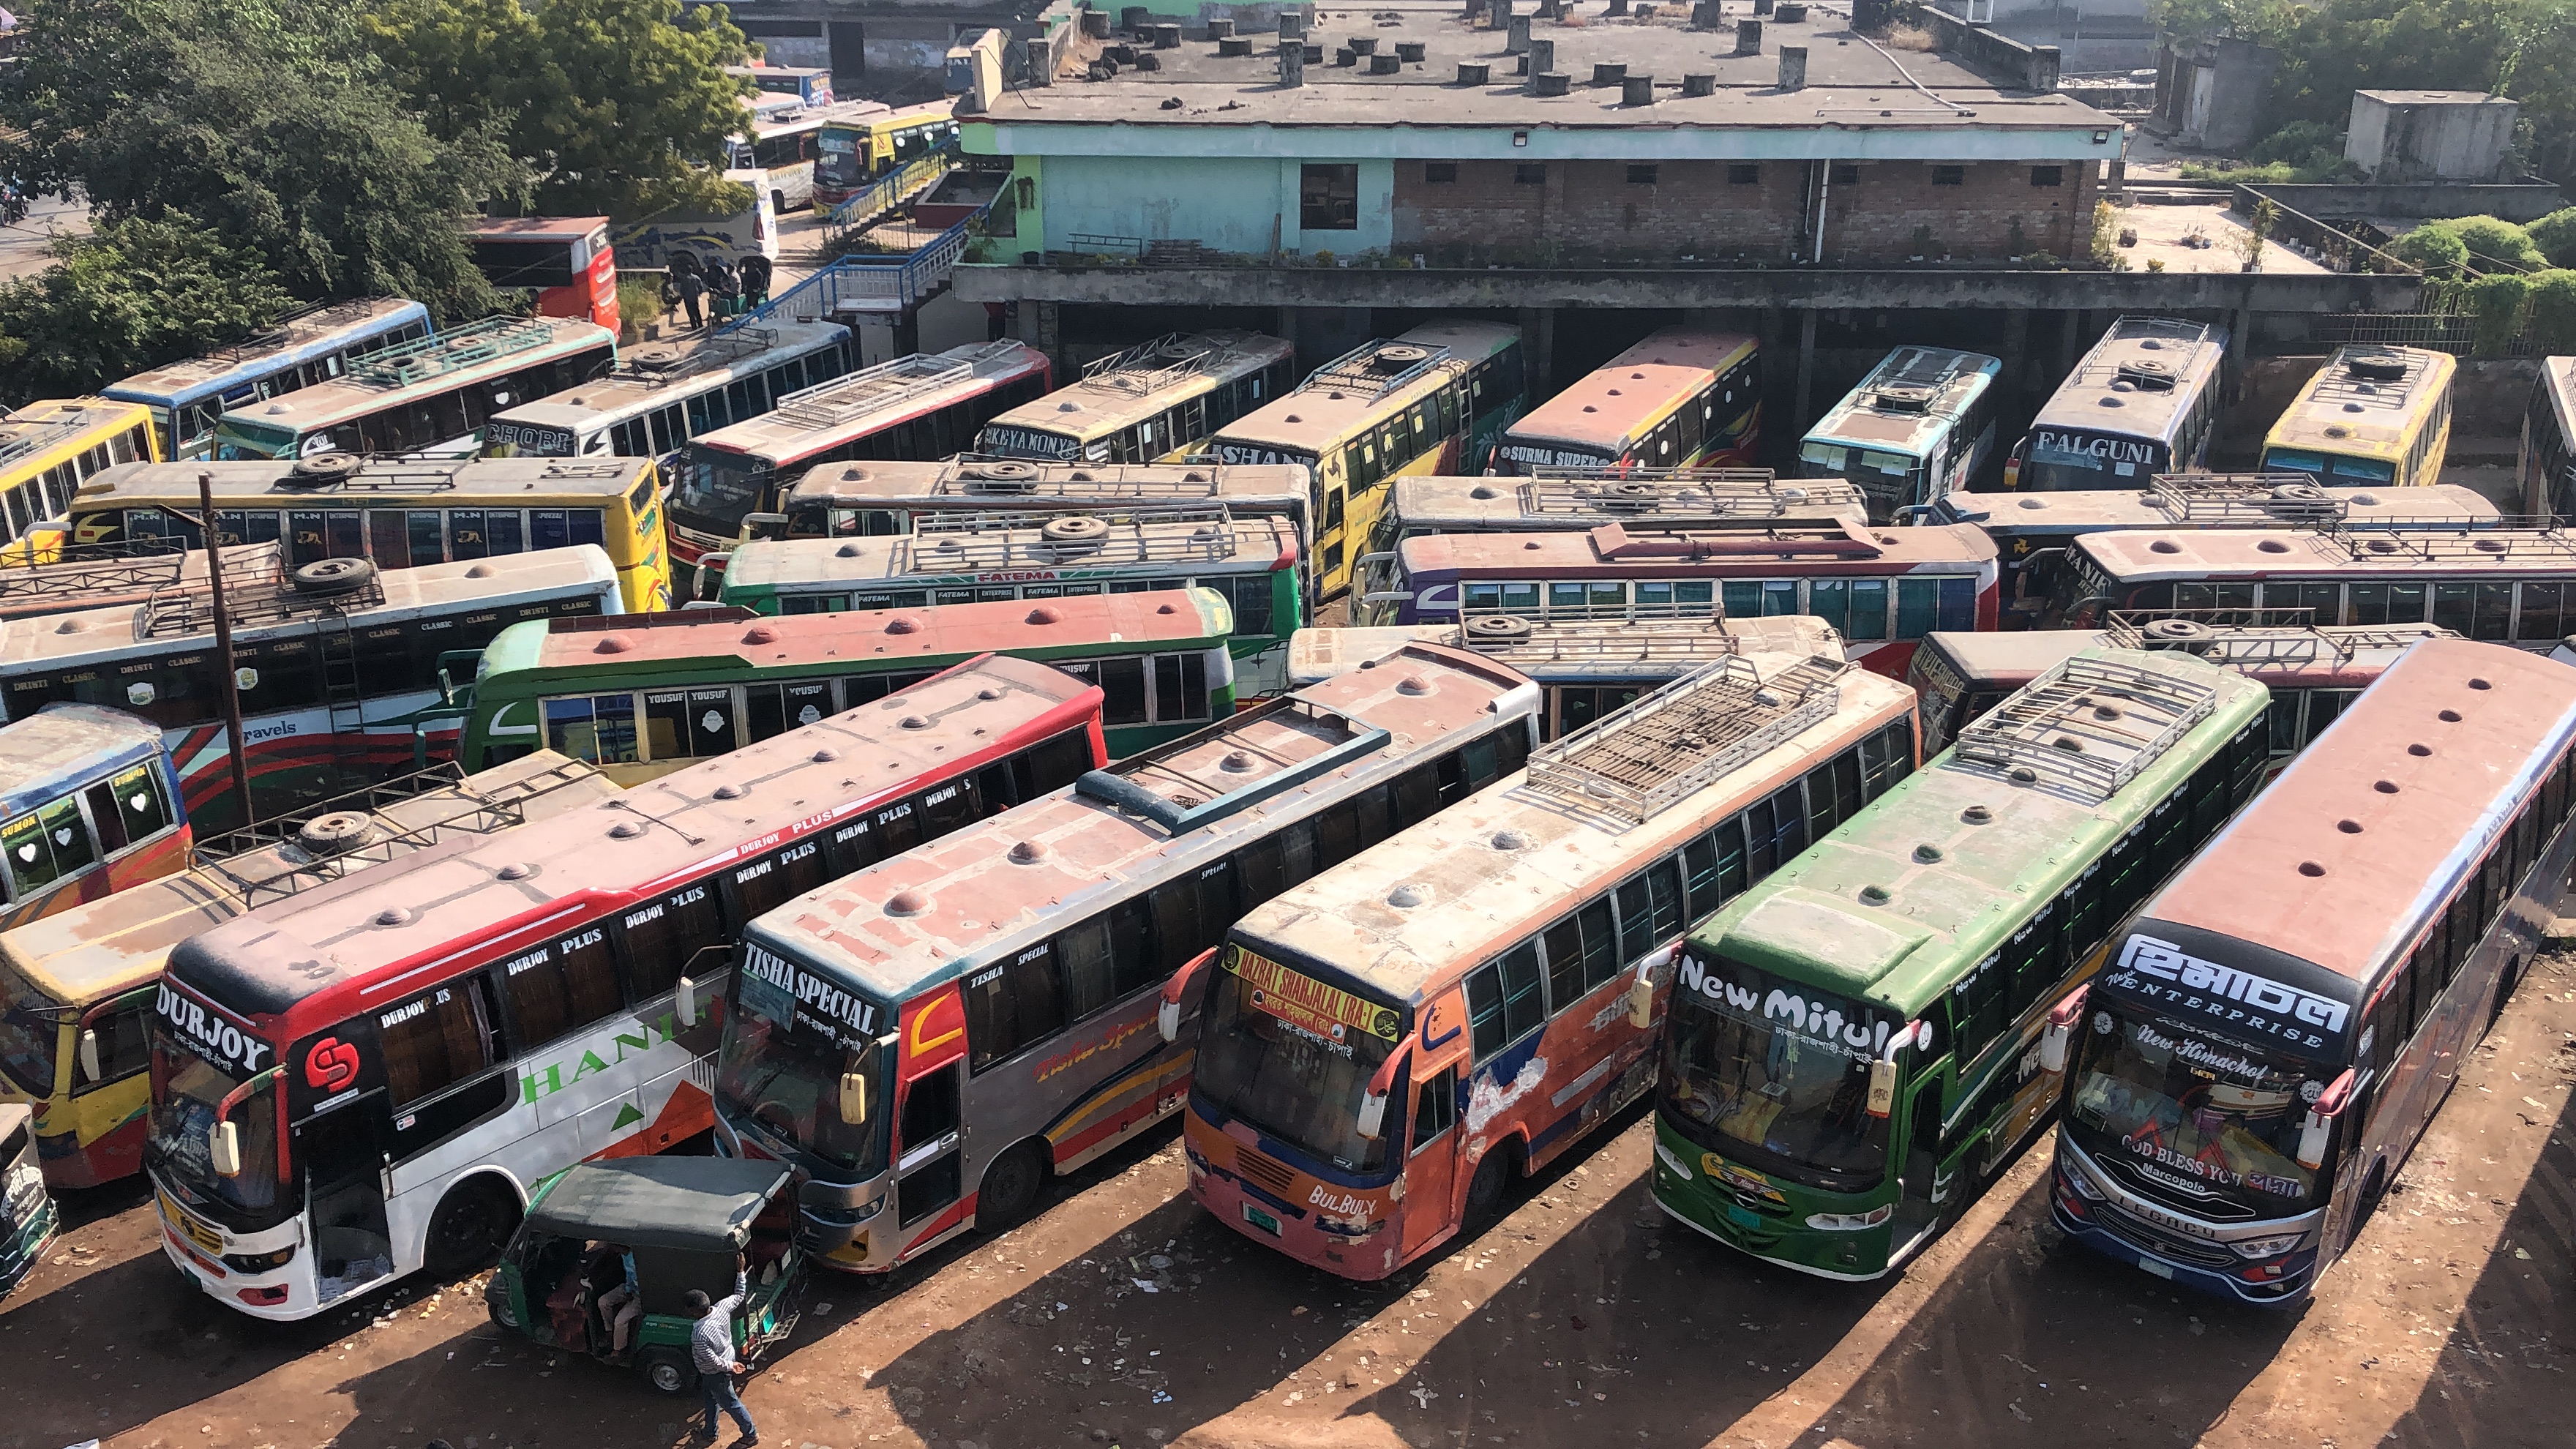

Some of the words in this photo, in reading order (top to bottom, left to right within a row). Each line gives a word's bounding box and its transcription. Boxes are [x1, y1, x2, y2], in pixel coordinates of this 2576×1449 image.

[992, 428, 1025, 449] KEYA
[1028, 433, 1068, 454] MONY
[2037, 431, 2153, 464] FALGUNI
[1510, 446, 1551, 464] SURMA
[1556, 452, 1598, 466] SUPER
[978, 571, 1056, 583] FATEMA
[1027, 587, 1059, 596] FATEMA
[1066, 585, 1098, 594] ENTERPRISE
[858, 594, 891, 603] FATEMA
[937, 590, 970, 598] FATEMA
[981, 588, 1013, 596] ENTERPRISE
[466, 613, 498, 624] CLASSIC
[520, 606, 549, 617] DRISTI
[561, 600, 592, 610] CLASSIC
[368, 628, 400, 638] CLASSIC
[421, 621, 453, 631] CLASSIC
[232, 648, 257, 658] RISTI
[274, 641, 305, 651] CLASSIC
[121, 662, 154, 674] DRISTI
[168, 656, 201, 667] CLASSIC
[13, 679, 48, 692] DRISTI
[62, 672, 97, 684] CLASSIC
[691, 690, 727, 701] YOUSUF
[648, 692, 684, 704] YOUSUF
[243, 721, 296, 742] ravels
[2235, 728, 2250, 745] New
[113, 765, 146, 787] SUMON
[925, 785, 957, 807] DURJOY
[2155, 800, 2171, 818] New
[2173, 781, 2189, 801] Mitul
[1, 815, 37, 839] SUMON
[740, 832, 780, 855] DURJOY
[791, 809, 832, 834] PLUS
[835, 820, 869, 843] DURJOY
[877, 802, 912, 825] PLUS
[2111, 838, 2129, 857] New
[2130, 819, 2146, 838] Mitul
[736, 860, 772, 884] DURJOY
[779, 841, 817, 866] PLUS
[2064, 880, 2082, 900] New
[2083, 859, 2101, 880] Mitul
[624, 903, 664, 929] DURJOY
[2013, 924, 2034, 946] New
[2034, 902, 2053, 926] Mitul
[506, 948, 549, 977] DURJOY
[560, 928, 602, 956] PLUS
[970, 965, 1004, 989] TISHA
[1017, 942, 1049, 966] SPECIAL
[1238, 950, 1281, 992] HAZRAT
[1279, 968, 1342, 1018] SHAHJALAL
[1955, 973, 1977, 996] New
[1980, 950, 2002, 974] Mitul
[2105, 970, 2136, 986] New
[2117, 933, 2351, 1033] হিমাচল
[744, 941, 795, 995] TISHA
[795, 973, 875, 1036] SPECIAL
[380, 999, 427, 1029] DURJOY
[1680, 954, 1759, 1011] New
[1764, 989, 1890, 1053] Mitul
[2119, 977, 2324, 1049] ENTERPRISE
[156, 981, 270, 1071] DURJOY
[2137, 1023, 2173, 1050] New
[2175, 1038, 2269, 1080] Himachol
[2155, 1146, 2204, 1177] BLESS
[2142, 1162, 2206, 1193] Marcopolo
[1308, 1184, 1378, 1216] BULBULY
